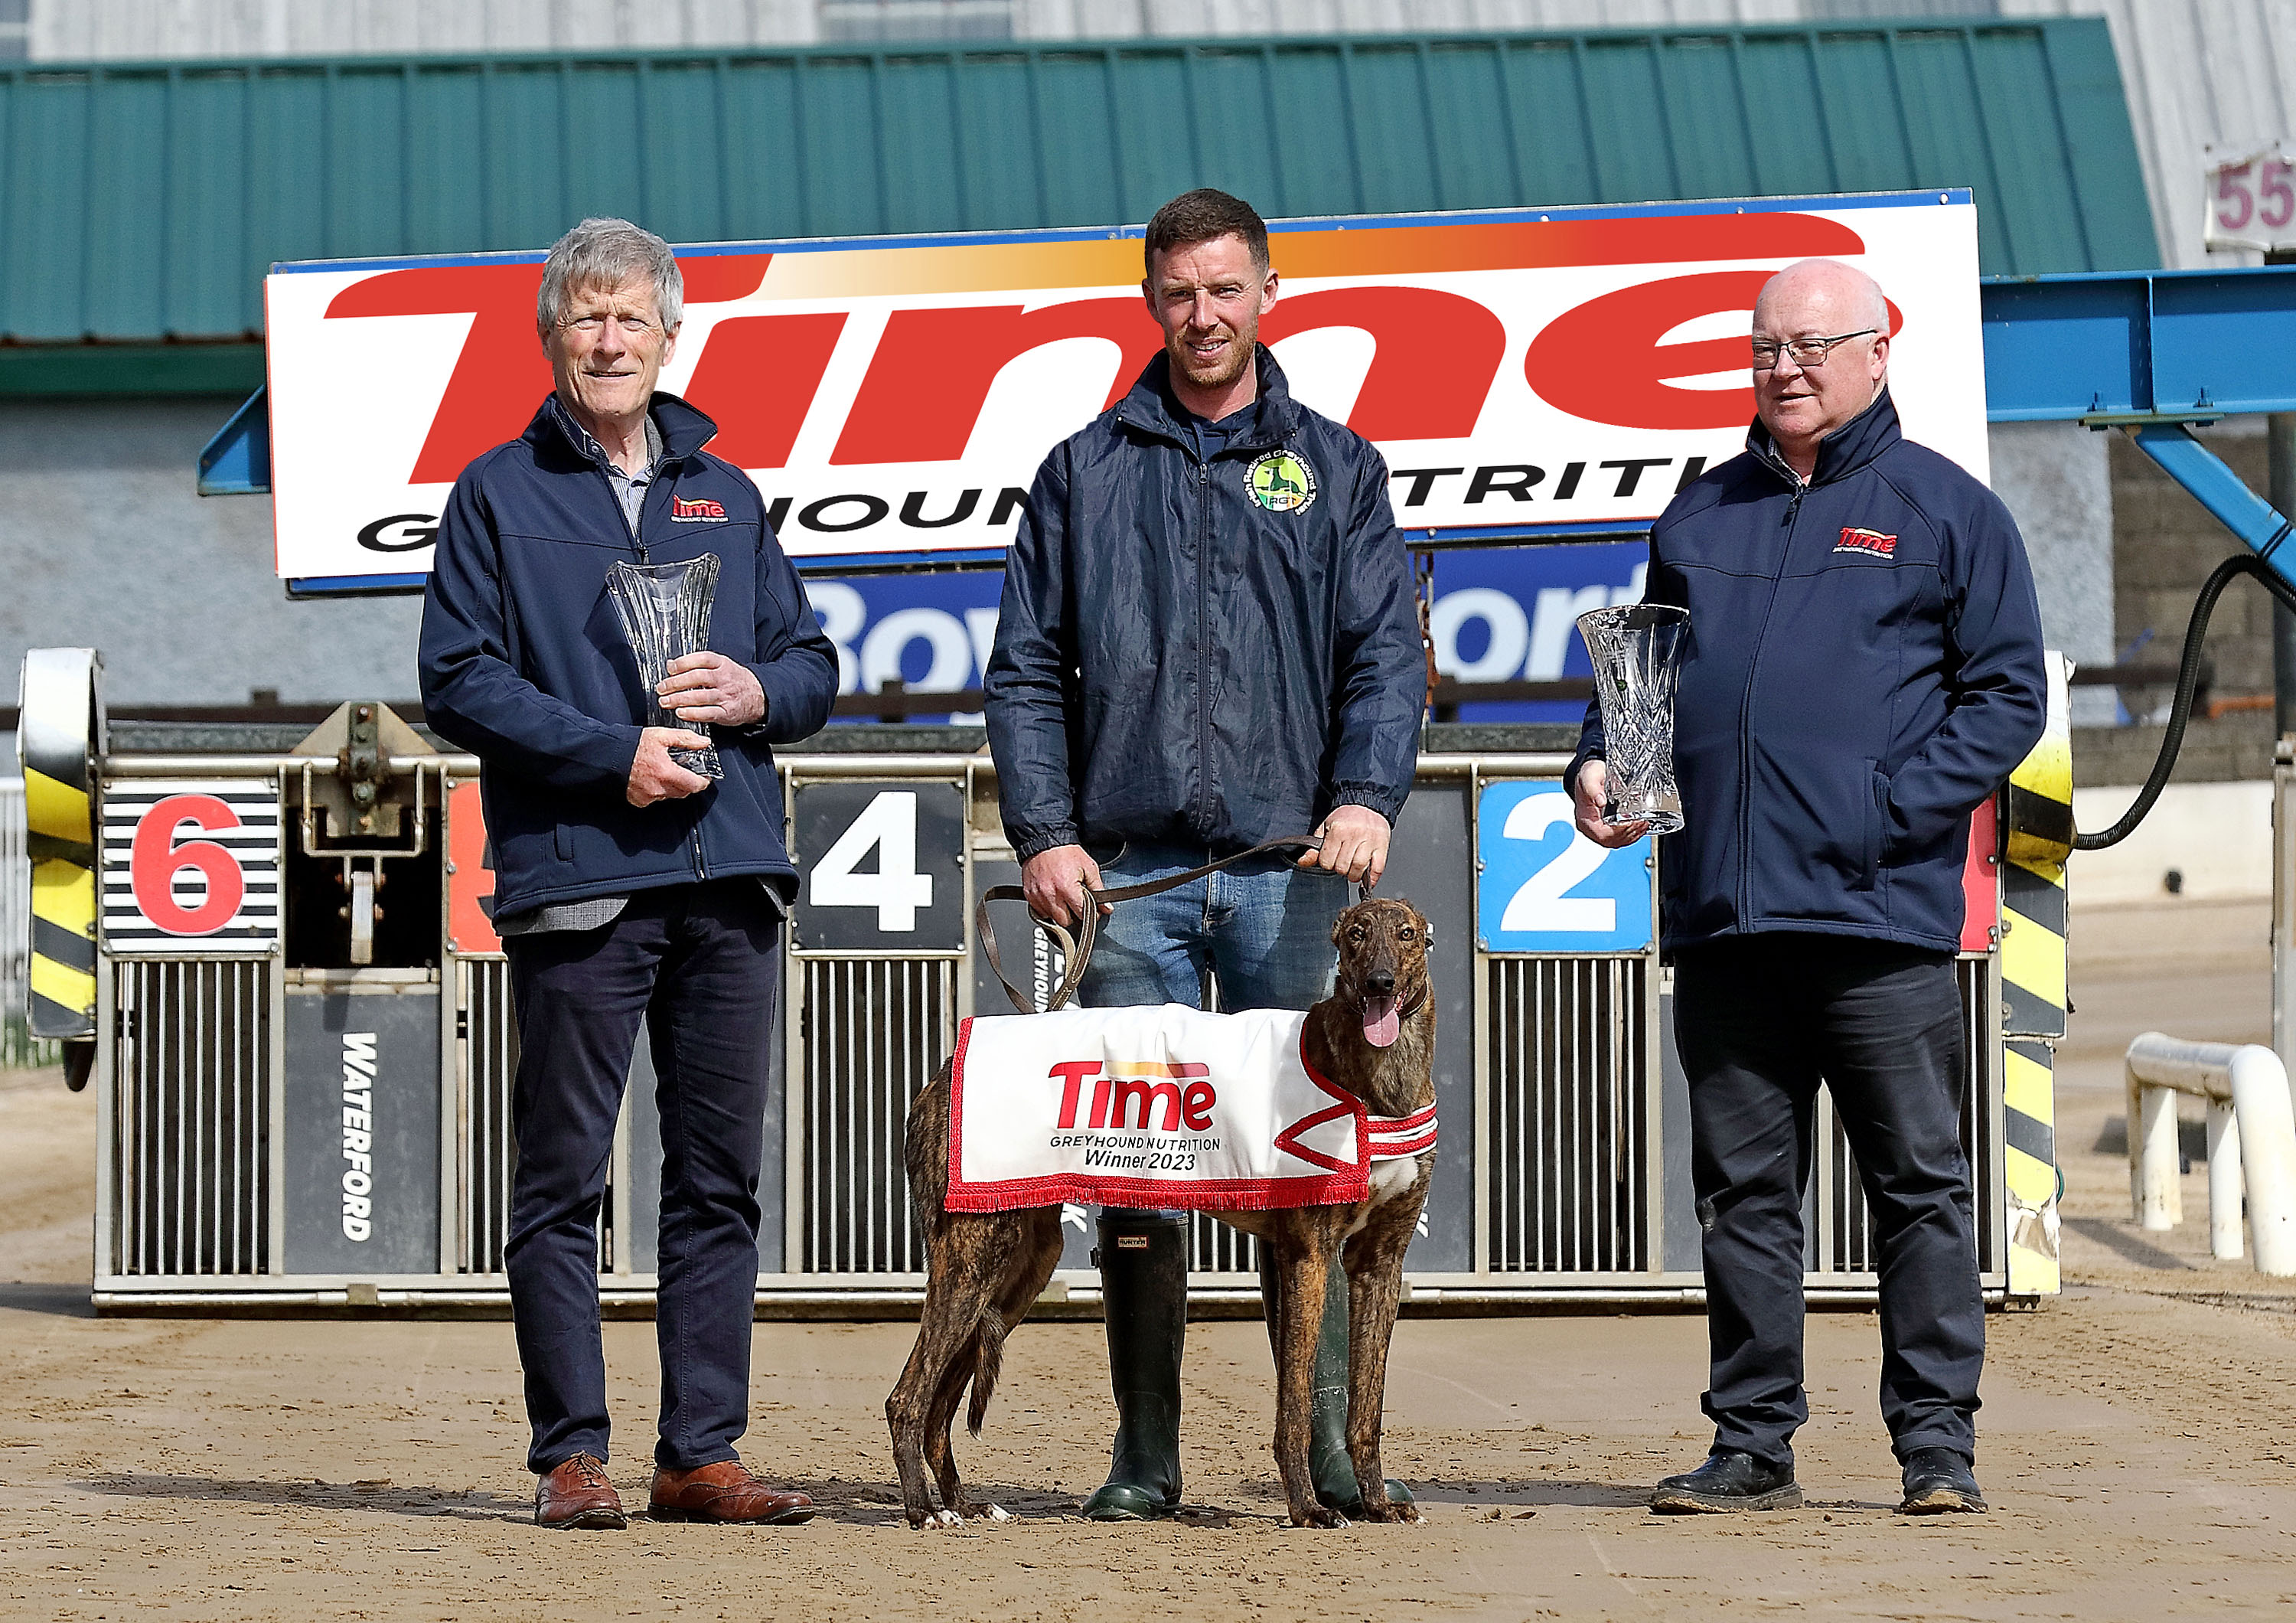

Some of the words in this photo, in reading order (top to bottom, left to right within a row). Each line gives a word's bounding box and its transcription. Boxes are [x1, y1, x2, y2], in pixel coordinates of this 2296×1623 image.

[2218, 160, 2294, 229] 55
[324, 212, 1903, 484] Time
[1243, 452, 1272, 483] Retired
[1244, 483, 1261, 508] Irish
[1274, 449, 1316, 491] Greyhound
[1390, 456, 1707, 507] TRITI
[1294, 491, 1316, 516] Trust
[1837, 527, 1897, 553] Time
[132, 795, 245, 935] 6
[810, 791, 933, 932] 4
[1501, 790, 1616, 932] 2
[1033, 926, 1049, 1013] GREYHOUN
[1049, 1060, 1217, 1132] Time
[342, 1033, 377, 1242] WATERFORD
[1050, 1135, 1144, 1149] GREYHOUND
[1146, 1137, 1220, 1151] NUTRITION
[1084, 1148, 1147, 1169] Winner
[1147, 1152, 1195, 1171] 2023
